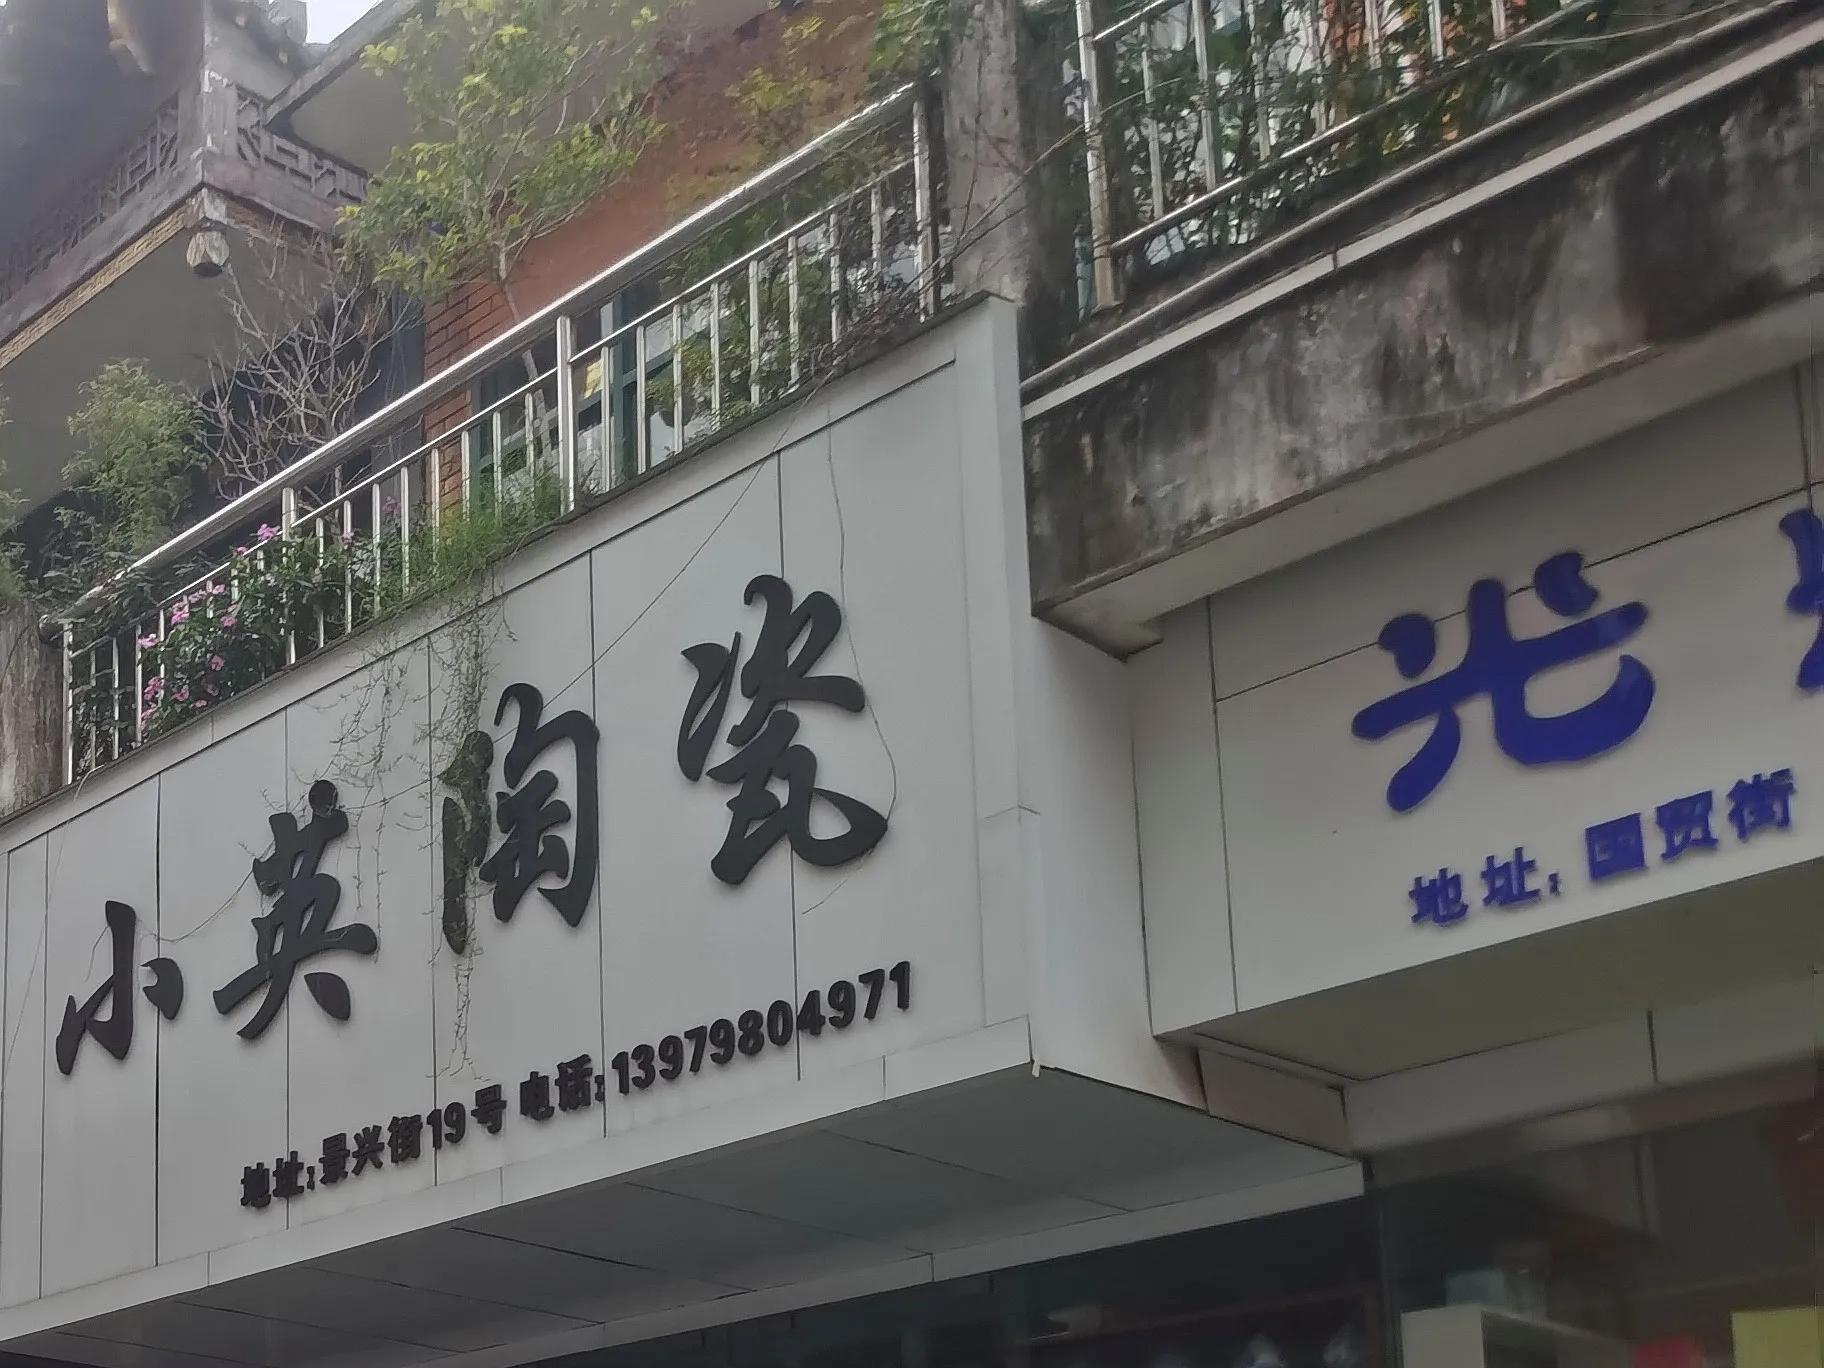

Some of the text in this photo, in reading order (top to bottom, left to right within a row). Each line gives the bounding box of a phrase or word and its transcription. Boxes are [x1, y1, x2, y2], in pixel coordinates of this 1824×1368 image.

[1351, 508, 1824, 814] 光
[55, 573, 889, 1075] 小英陶瓷
[519, 961, 912, 1120] 电话:13979804971
